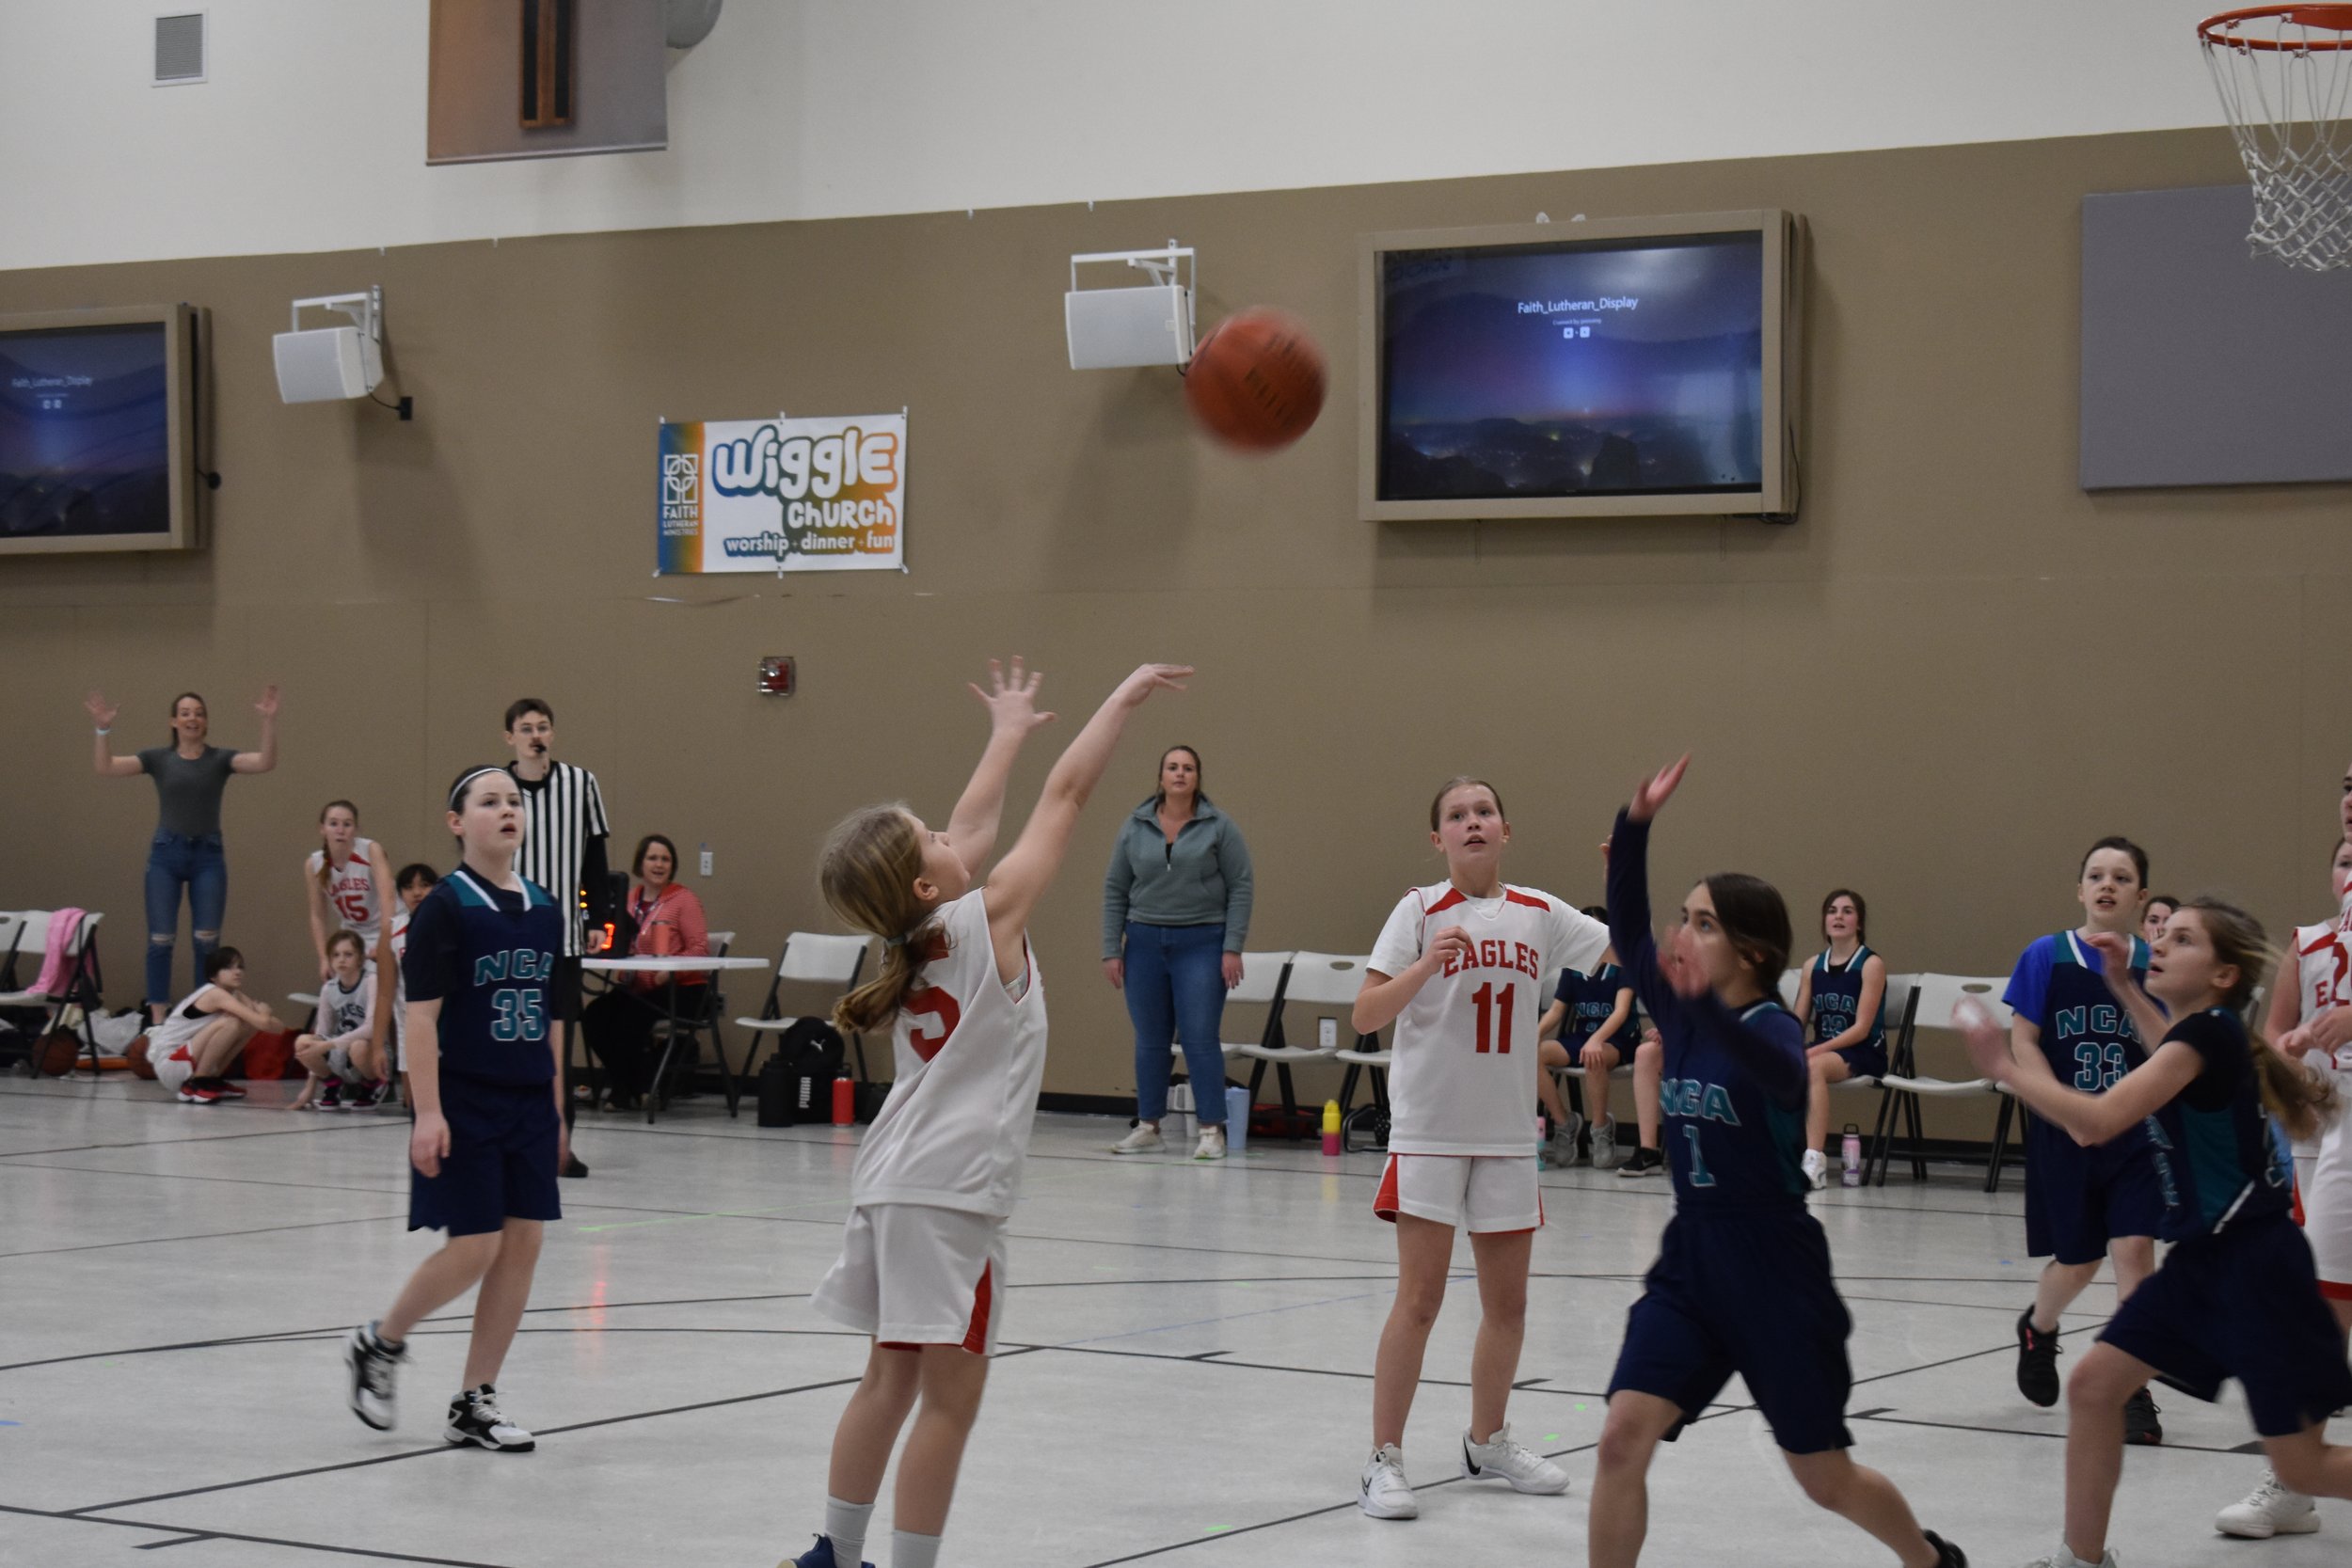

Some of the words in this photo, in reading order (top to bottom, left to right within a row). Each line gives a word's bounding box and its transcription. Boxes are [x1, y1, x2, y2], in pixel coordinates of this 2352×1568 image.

[1518, 296, 1639, 314] Faith_Lutheran_Display
[663, 505, 698, 518] FAITH
[725, 532, 789, 557] worship
[802, 531, 855, 550] dinner
[866, 531, 894, 548] fun
[335, 895, 370, 922] 15
[490, 989, 545, 1041] 35
[1471, 981, 1516, 1054] 11
[2074, 1042, 2128, 1091] 33
[799, 1076, 812, 1109] PUMA
[1682, 1123, 1718, 1188] 1
